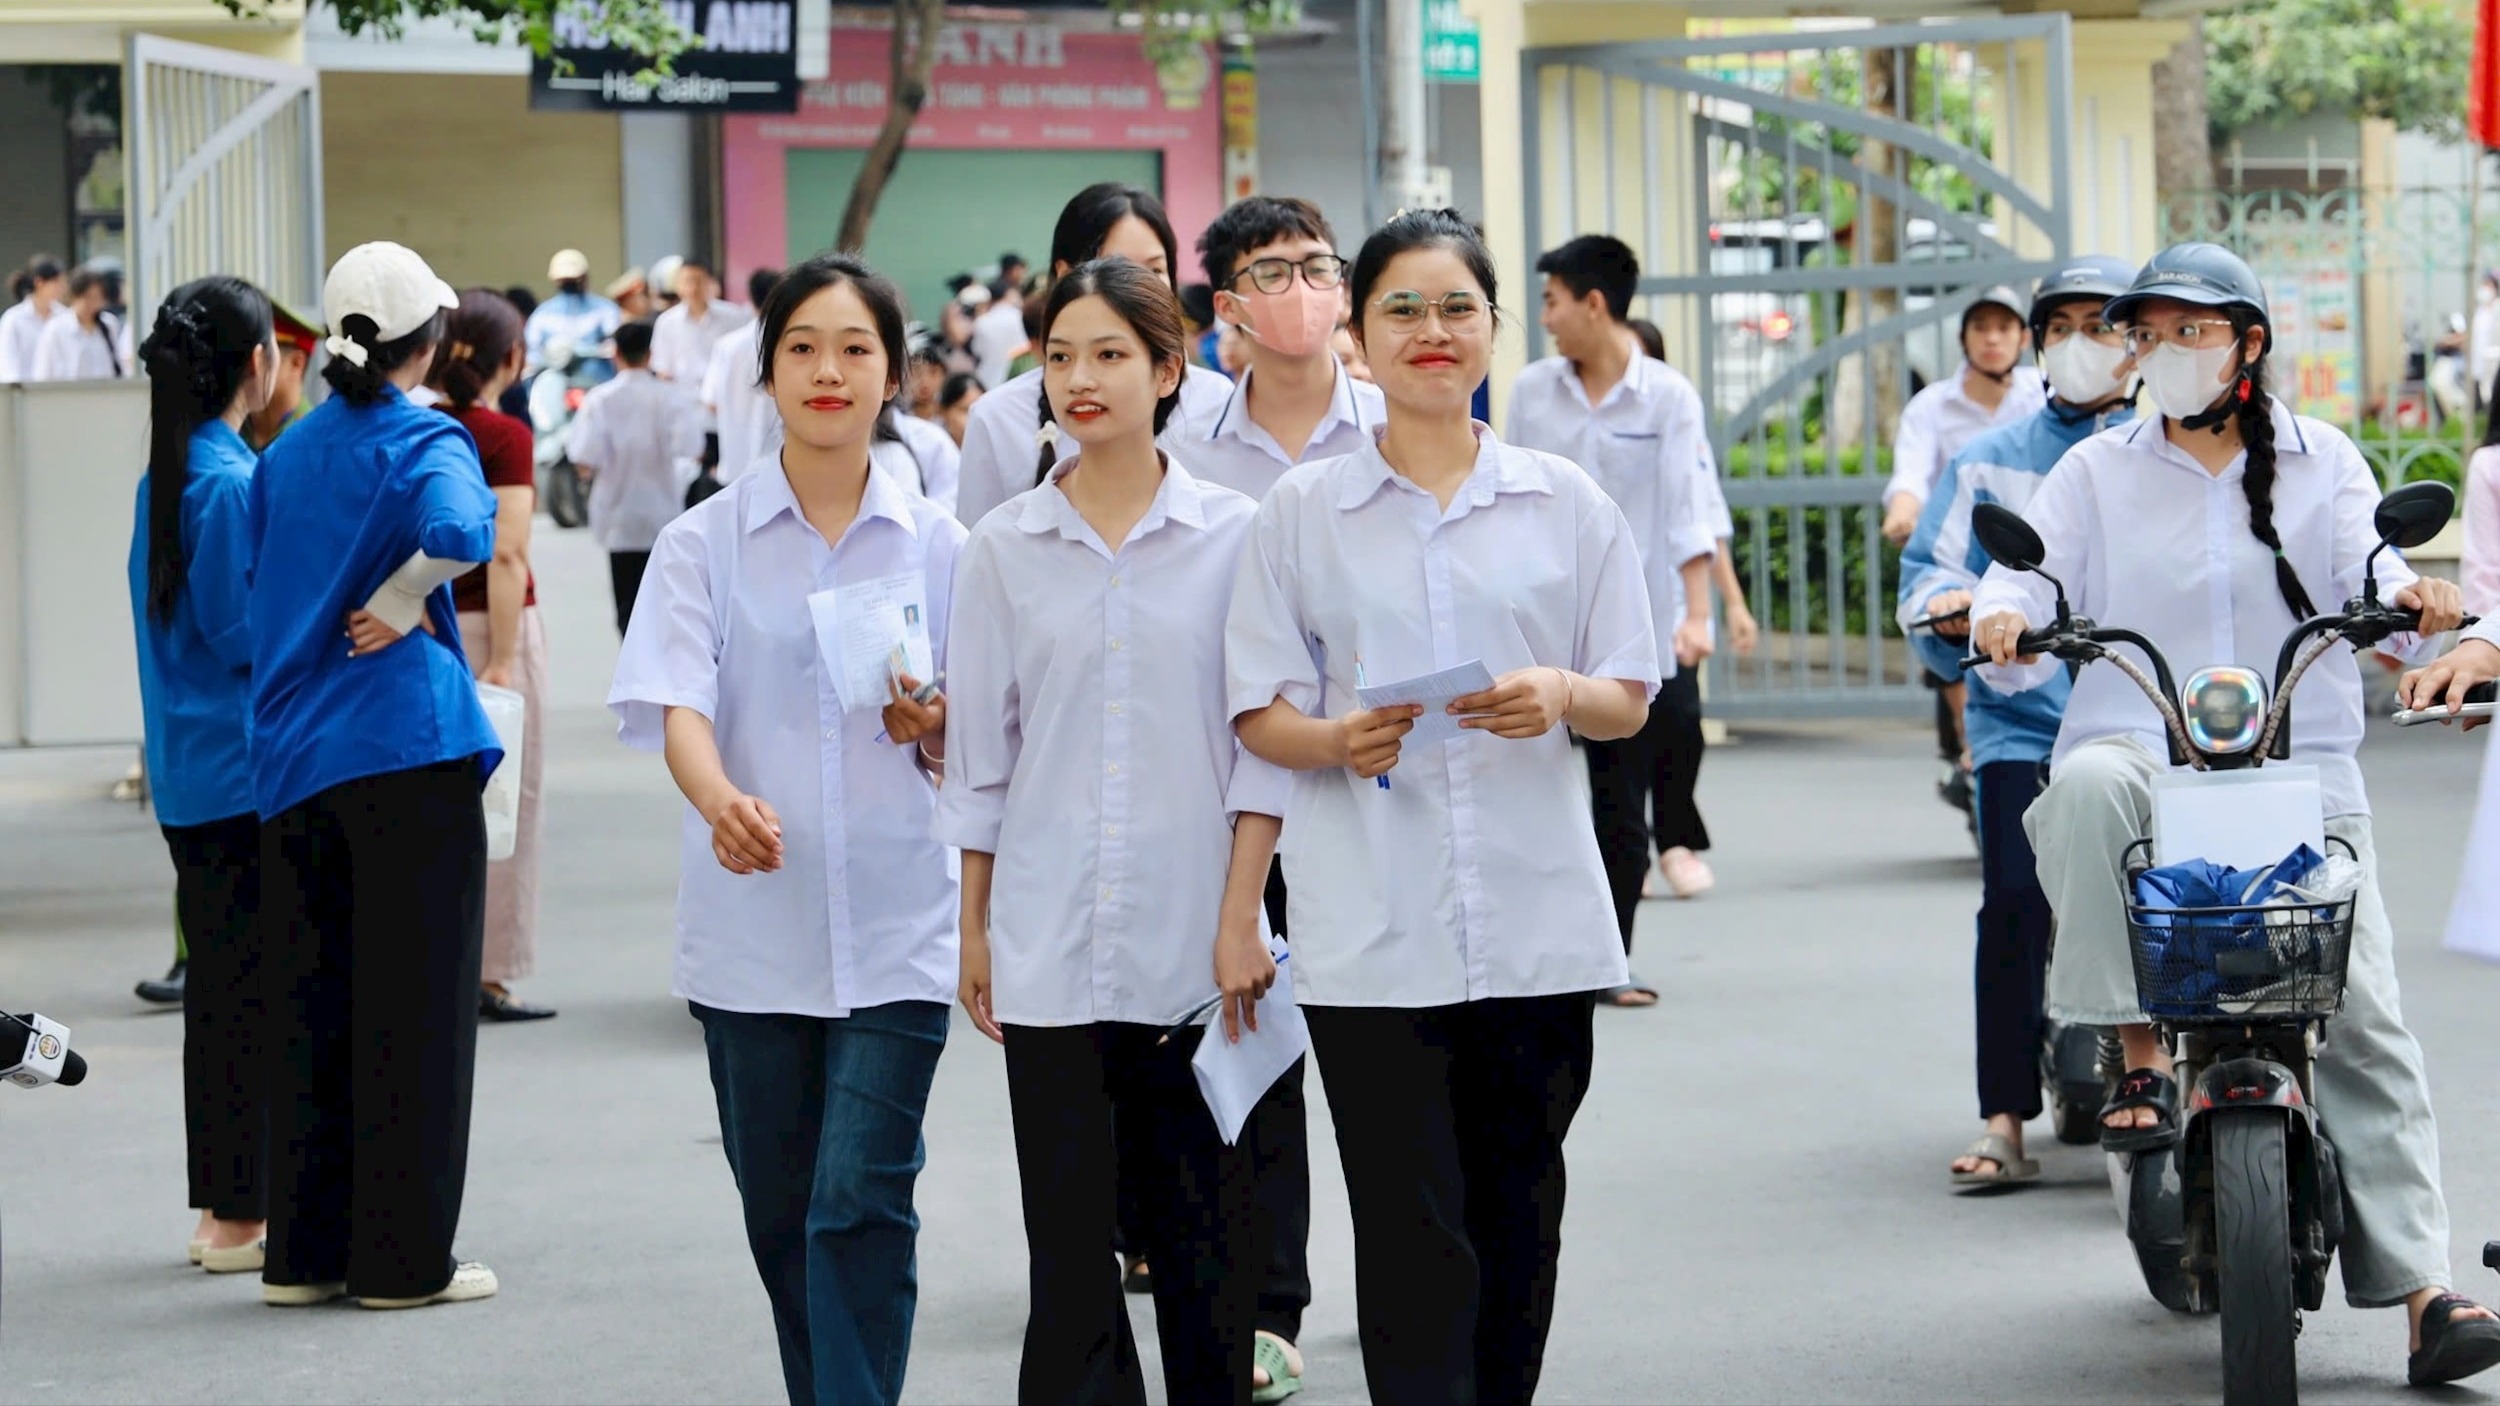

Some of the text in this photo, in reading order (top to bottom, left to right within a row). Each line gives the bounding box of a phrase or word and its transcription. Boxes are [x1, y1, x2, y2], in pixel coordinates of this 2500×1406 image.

[704, 2, 791, 51] ANH
[602, 68, 730, 104] Hair Salon
